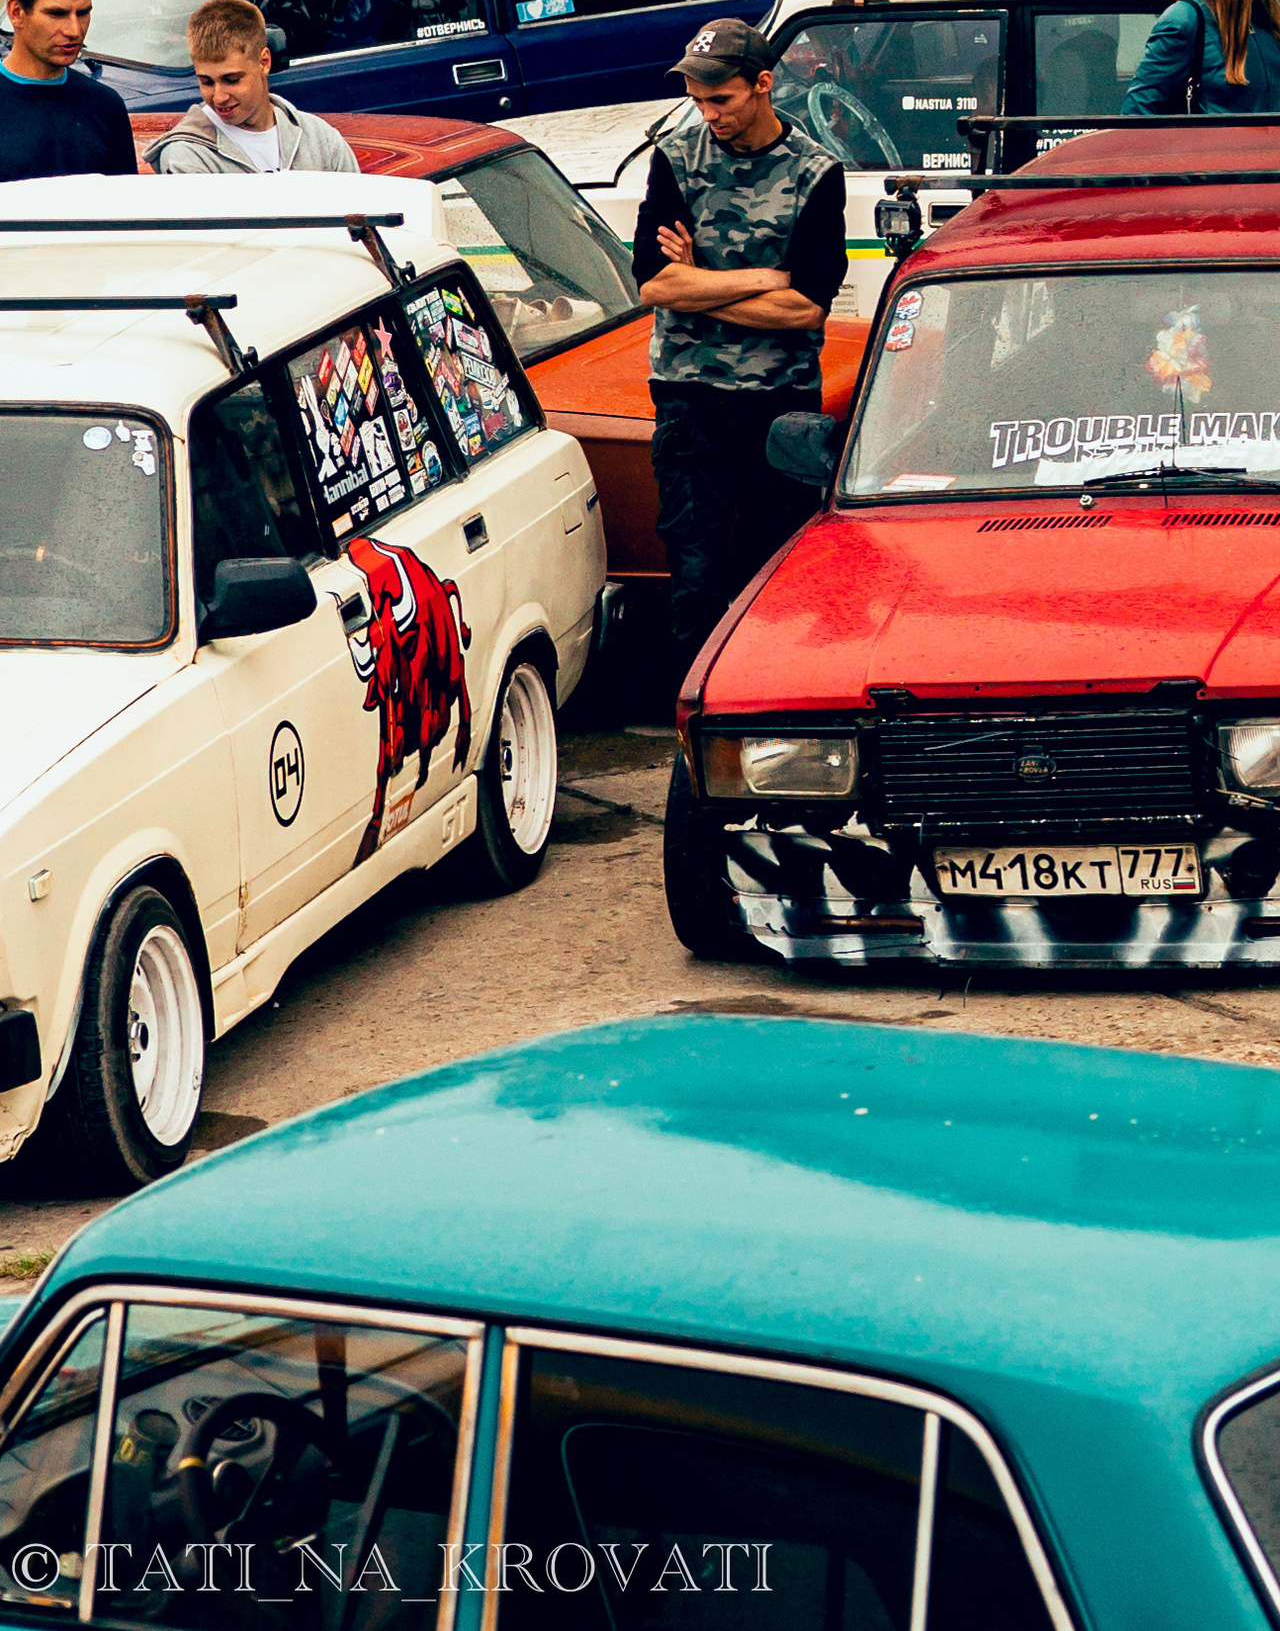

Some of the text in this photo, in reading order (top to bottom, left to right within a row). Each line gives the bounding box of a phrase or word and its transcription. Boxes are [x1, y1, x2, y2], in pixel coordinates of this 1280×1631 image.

[417, 18, 486, 38] #ОТВЕРНИСЬ
[915, 97, 978, 110] NASTUA 3110
[990, 414, 1184, 469] TROUBLE
[1121, 848, 1184, 878] 777
[1141, 878, 1172, 890] RUS
